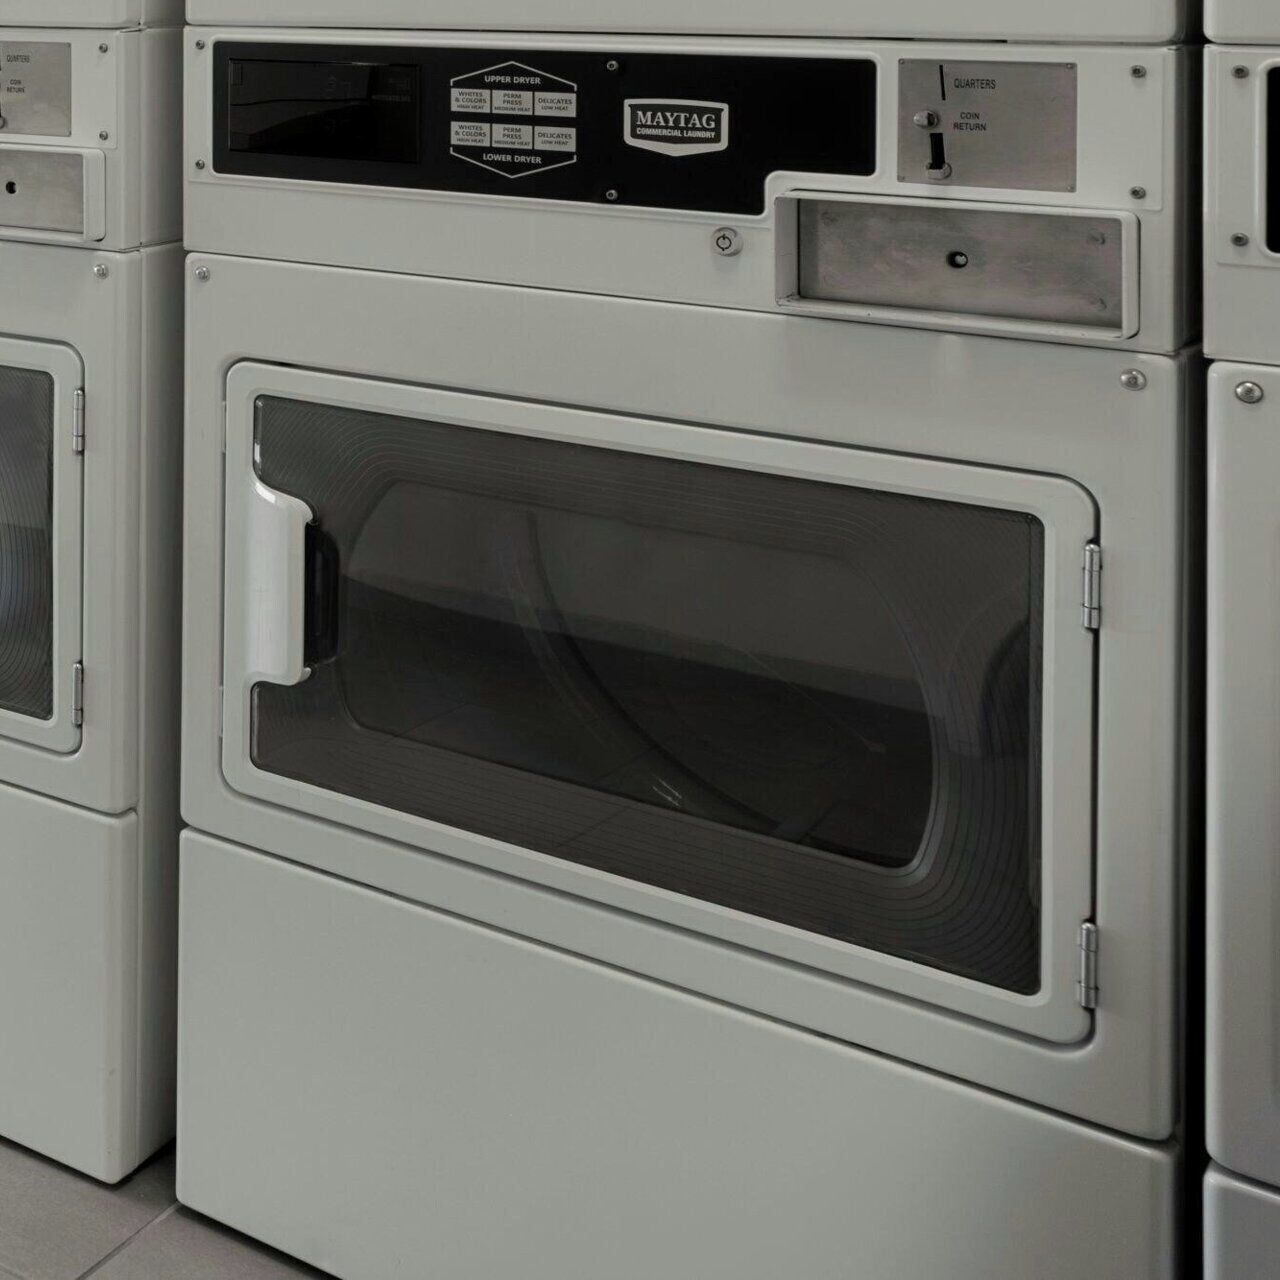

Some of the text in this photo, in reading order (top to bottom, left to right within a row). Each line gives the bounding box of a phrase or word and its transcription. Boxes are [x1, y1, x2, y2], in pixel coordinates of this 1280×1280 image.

[485, 75, 541, 85] UPPER DRYER
[954, 78, 996, 89] QUARTERS
[636, 110, 716, 129] MAYTAG
[960, 112, 980, 120] COIN
[953, 122, 987, 131] RETURN
[462, 130, 487, 138] COLORS
[538, 132, 572, 140] DELICATES
[636, 127, 715, 138] COMMERCIAL LAUNDRY
[483, 153, 542, 164] LOWER DRYER
